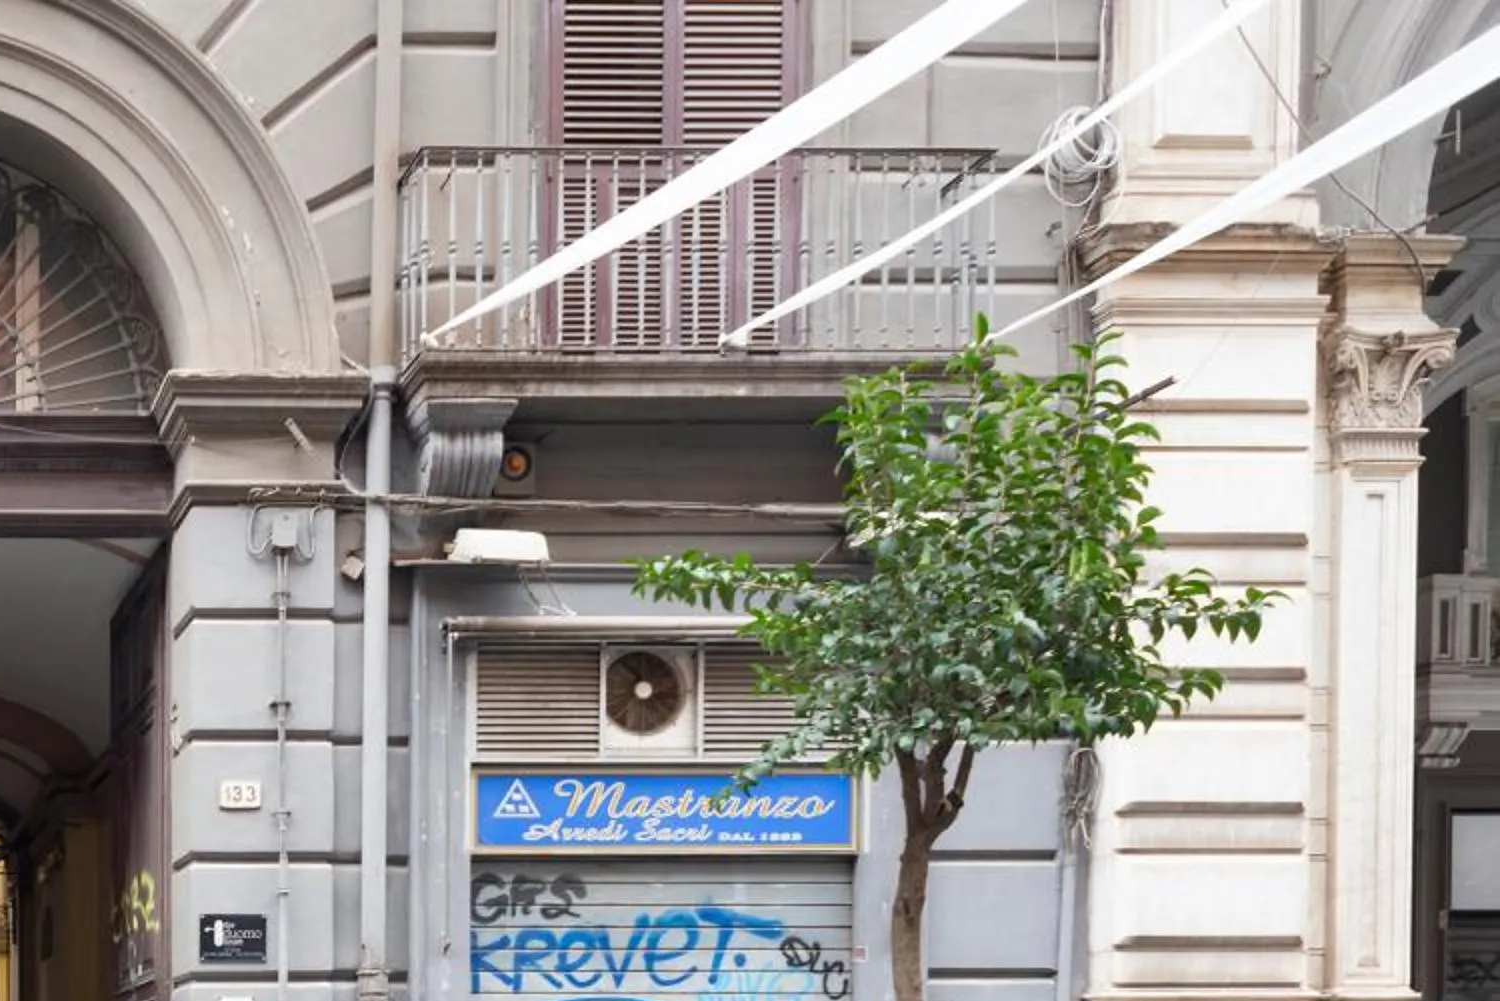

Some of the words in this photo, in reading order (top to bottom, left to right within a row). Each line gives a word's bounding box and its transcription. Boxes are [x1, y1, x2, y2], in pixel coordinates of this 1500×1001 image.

[224, 786, 258, 802] 133
[553, 778, 837, 819] Mastranzo
[522, 818, 628, 842] Arredi
[634, 816, 714, 842] Sacri
[717, 831, 756, 841] DAL
